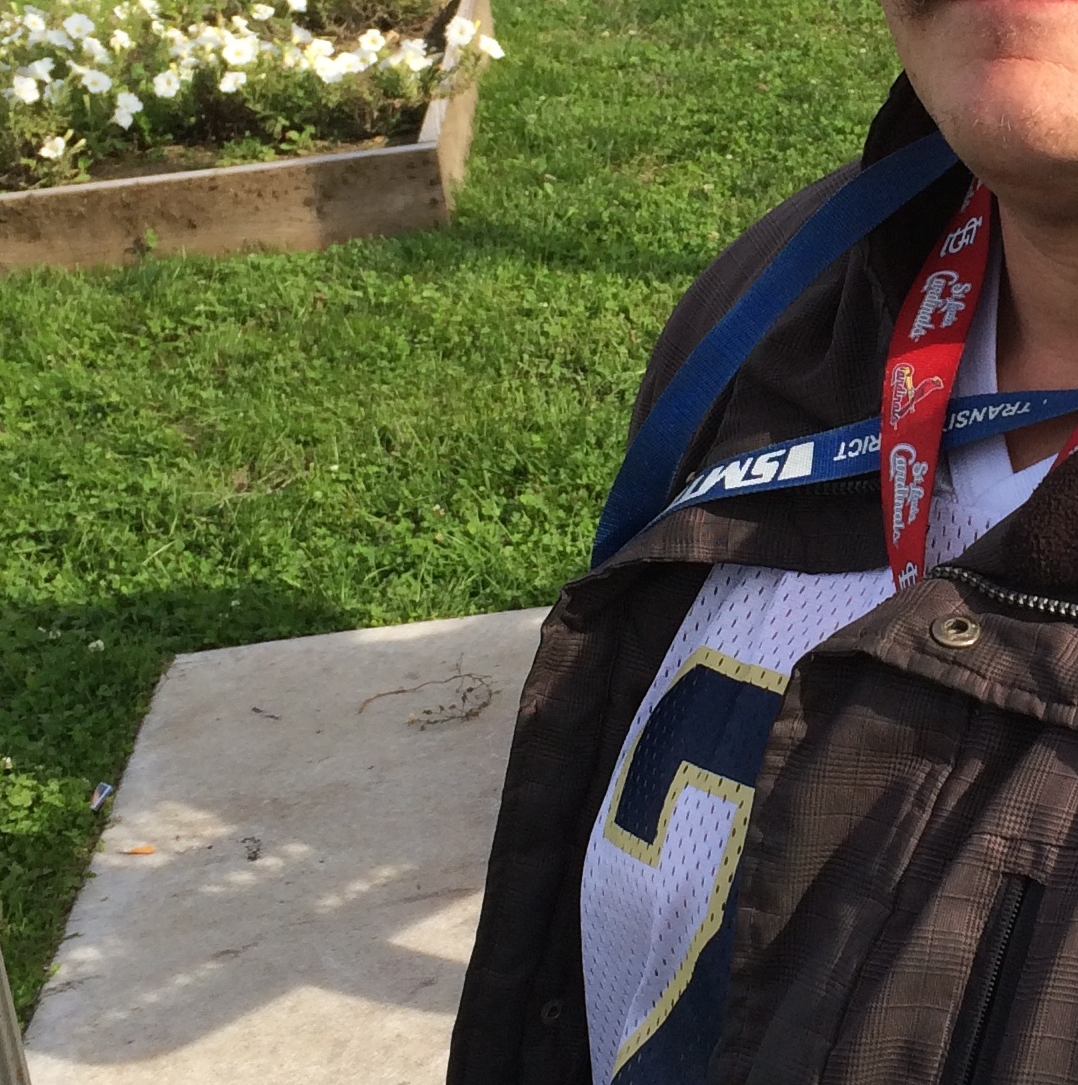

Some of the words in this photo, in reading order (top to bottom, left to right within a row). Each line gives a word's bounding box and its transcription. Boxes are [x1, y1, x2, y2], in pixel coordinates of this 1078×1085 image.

[908, 269, 959, 343] Cardinals
[833, 432, 881, 462] RICT
[943, 400, 1031, 433] TRANSI
[662, 448, 787, 512] SMT
[889, 442, 917, 549] Cardinals
